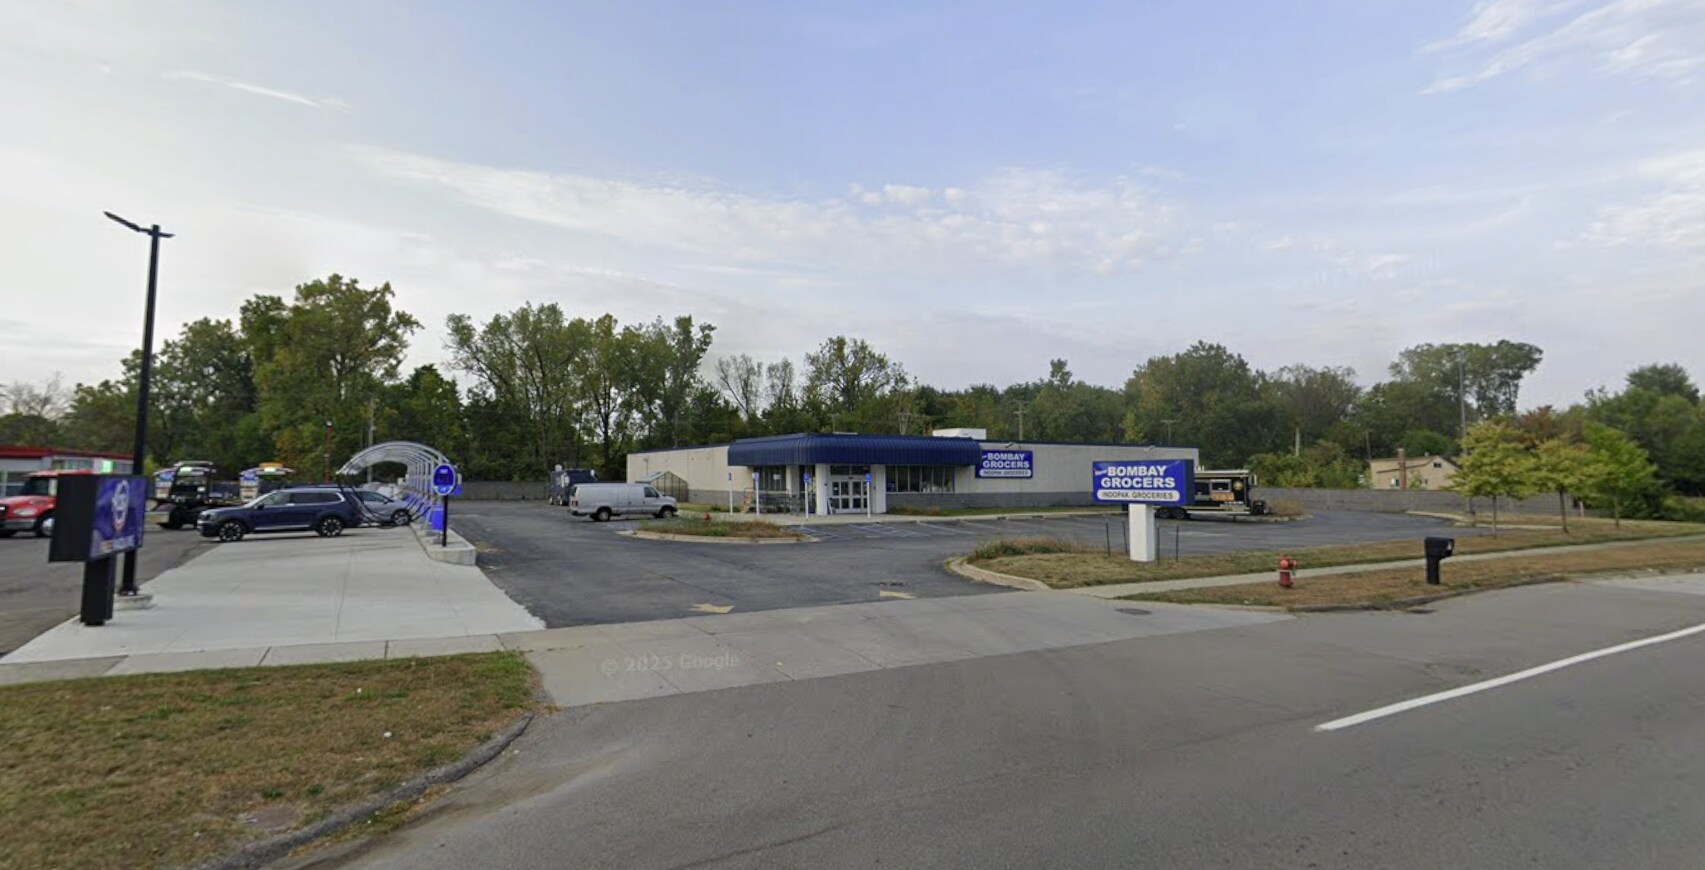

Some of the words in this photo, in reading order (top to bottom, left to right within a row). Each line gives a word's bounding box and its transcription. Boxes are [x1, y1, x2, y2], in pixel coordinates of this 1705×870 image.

[982, 460, 1030, 468] GROCERS
[1107, 466, 1167, 476] BOMBAY
[1100, 477, 1176, 488] GROCERS
[1132, 491, 1173, 500] GROCERIES
